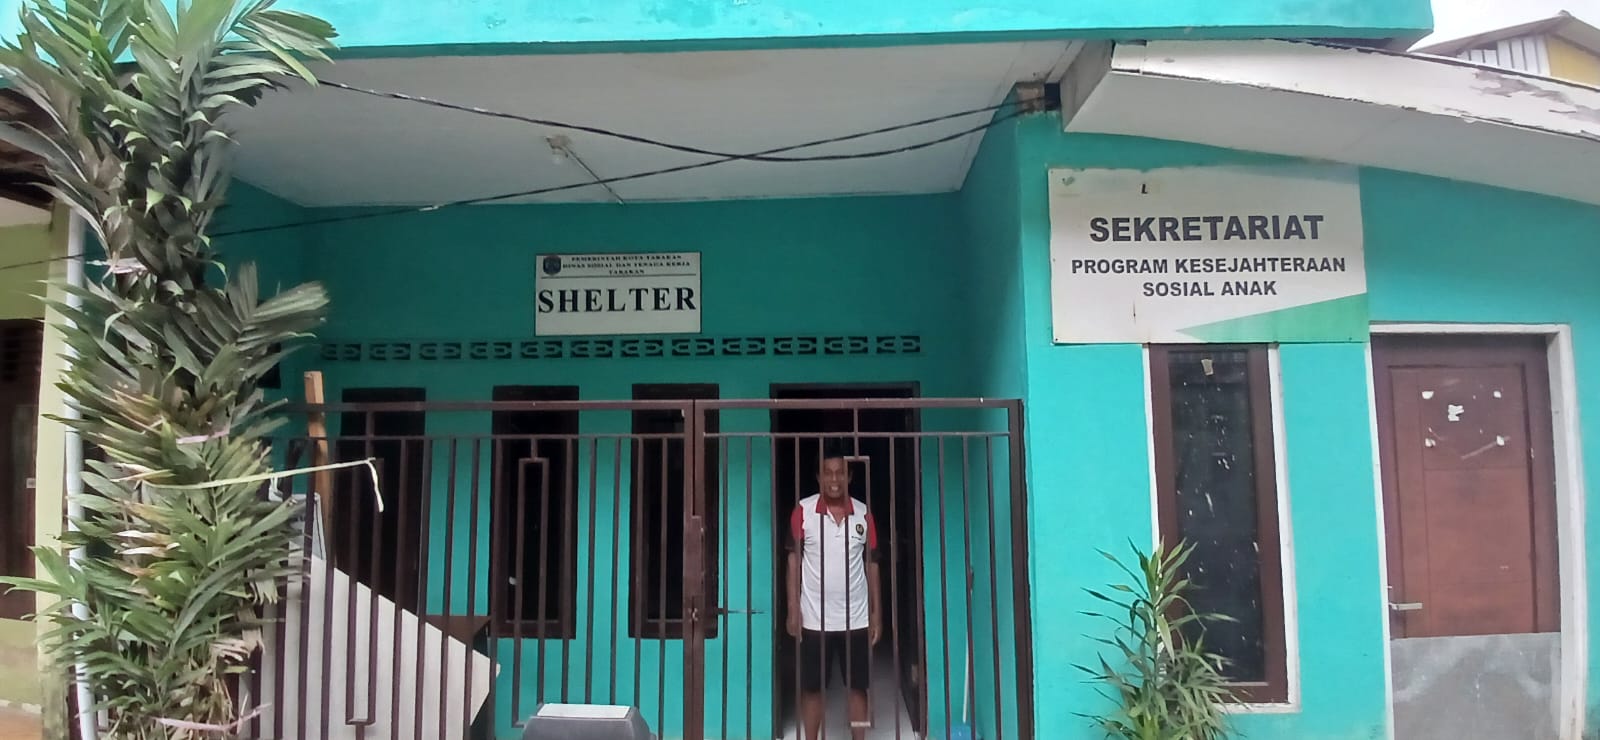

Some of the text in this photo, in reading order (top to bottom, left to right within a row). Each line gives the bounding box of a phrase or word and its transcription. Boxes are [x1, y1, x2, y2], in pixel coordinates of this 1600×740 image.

[1089, 215, 1324, 242] SEKRETARIAT
[1071, 257, 1346, 274] PROGRAM KESEJAHTERAAN
[1142, 280, 1278, 297] SOSIAL ANAK
[538, 287, 697, 313] SHELTER
